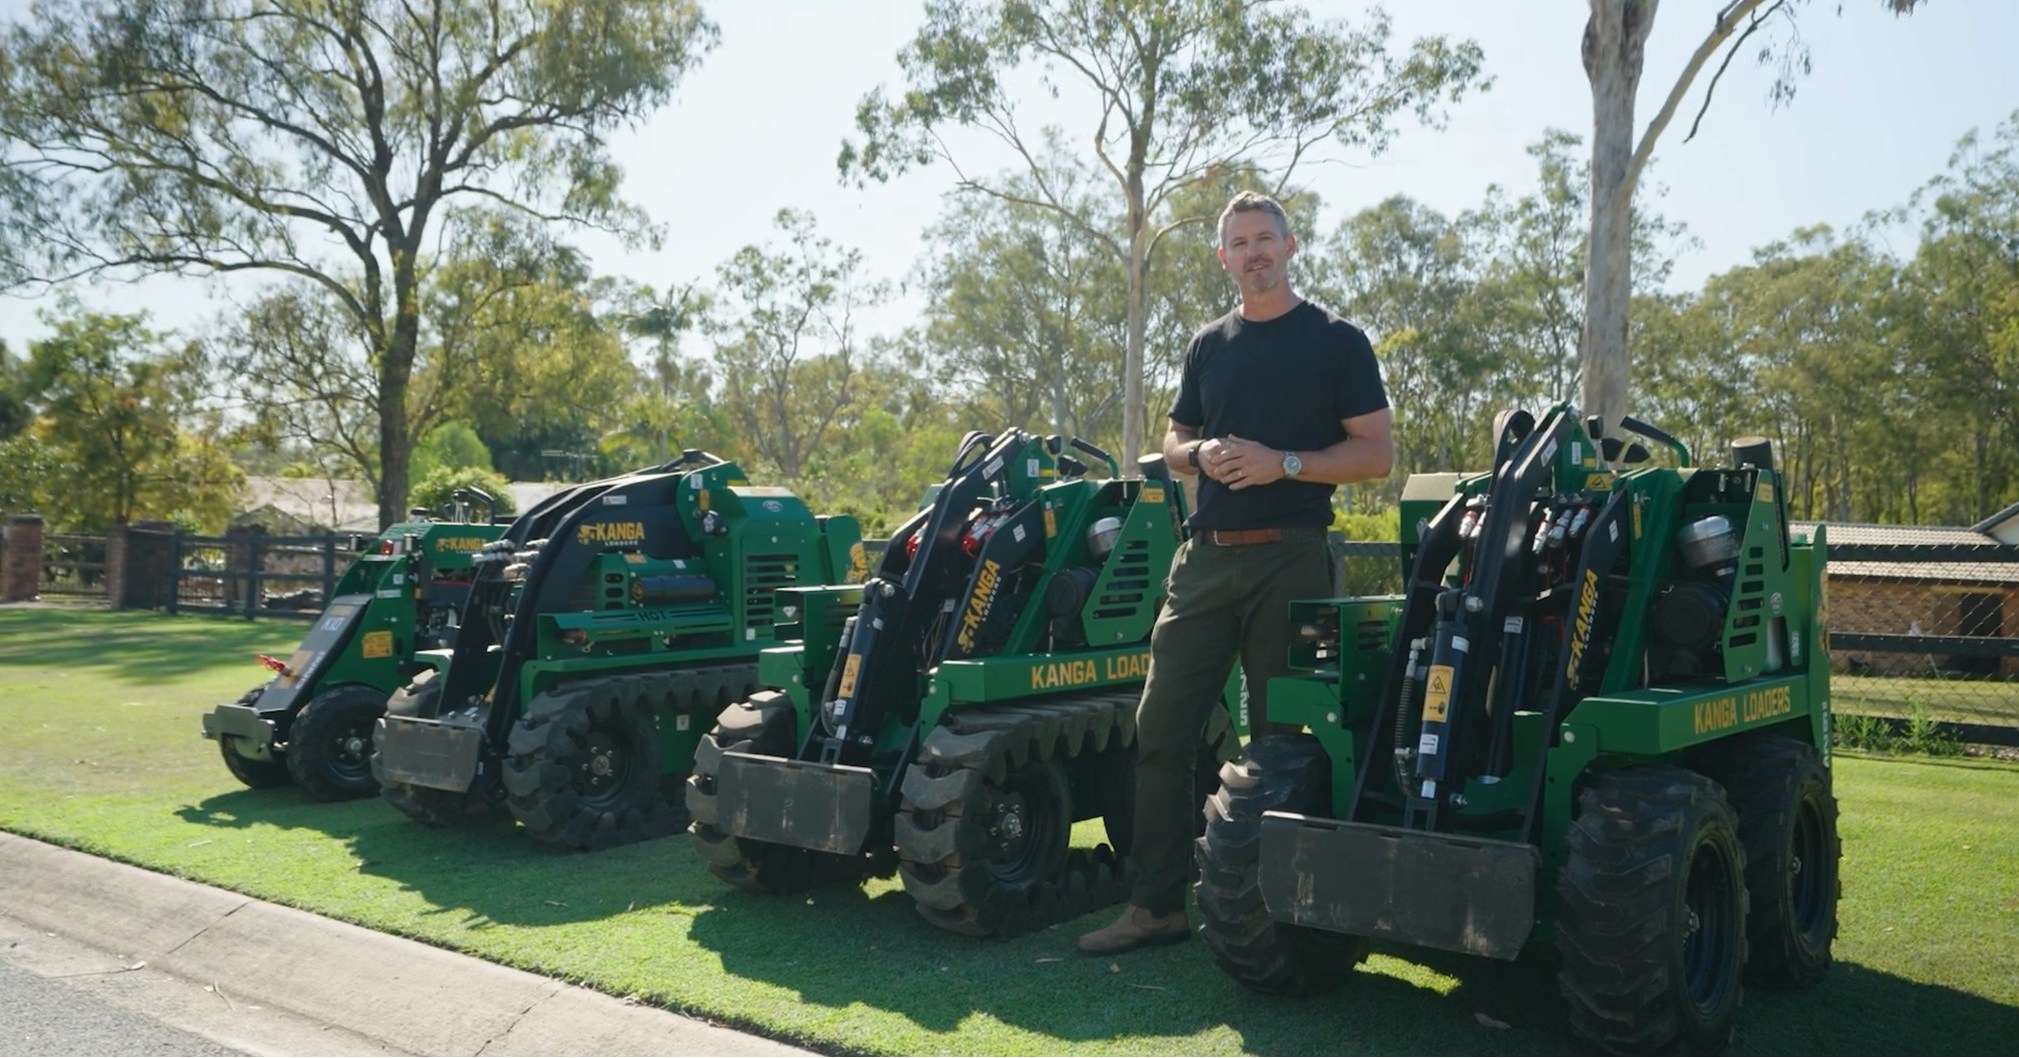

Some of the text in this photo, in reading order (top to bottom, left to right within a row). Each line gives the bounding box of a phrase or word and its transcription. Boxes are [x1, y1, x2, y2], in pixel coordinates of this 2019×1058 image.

[596, 522, 645, 540] KANGA
[638, 610, 667, 622] HOT
[964, 559, 1001, 630] KANGA
[1571, 568, 1598, 659] KANGA
[1031, 652, 1152, 690] KANGA LOAD
[1695, 685, 1791, 735] KANGA LOADERS
